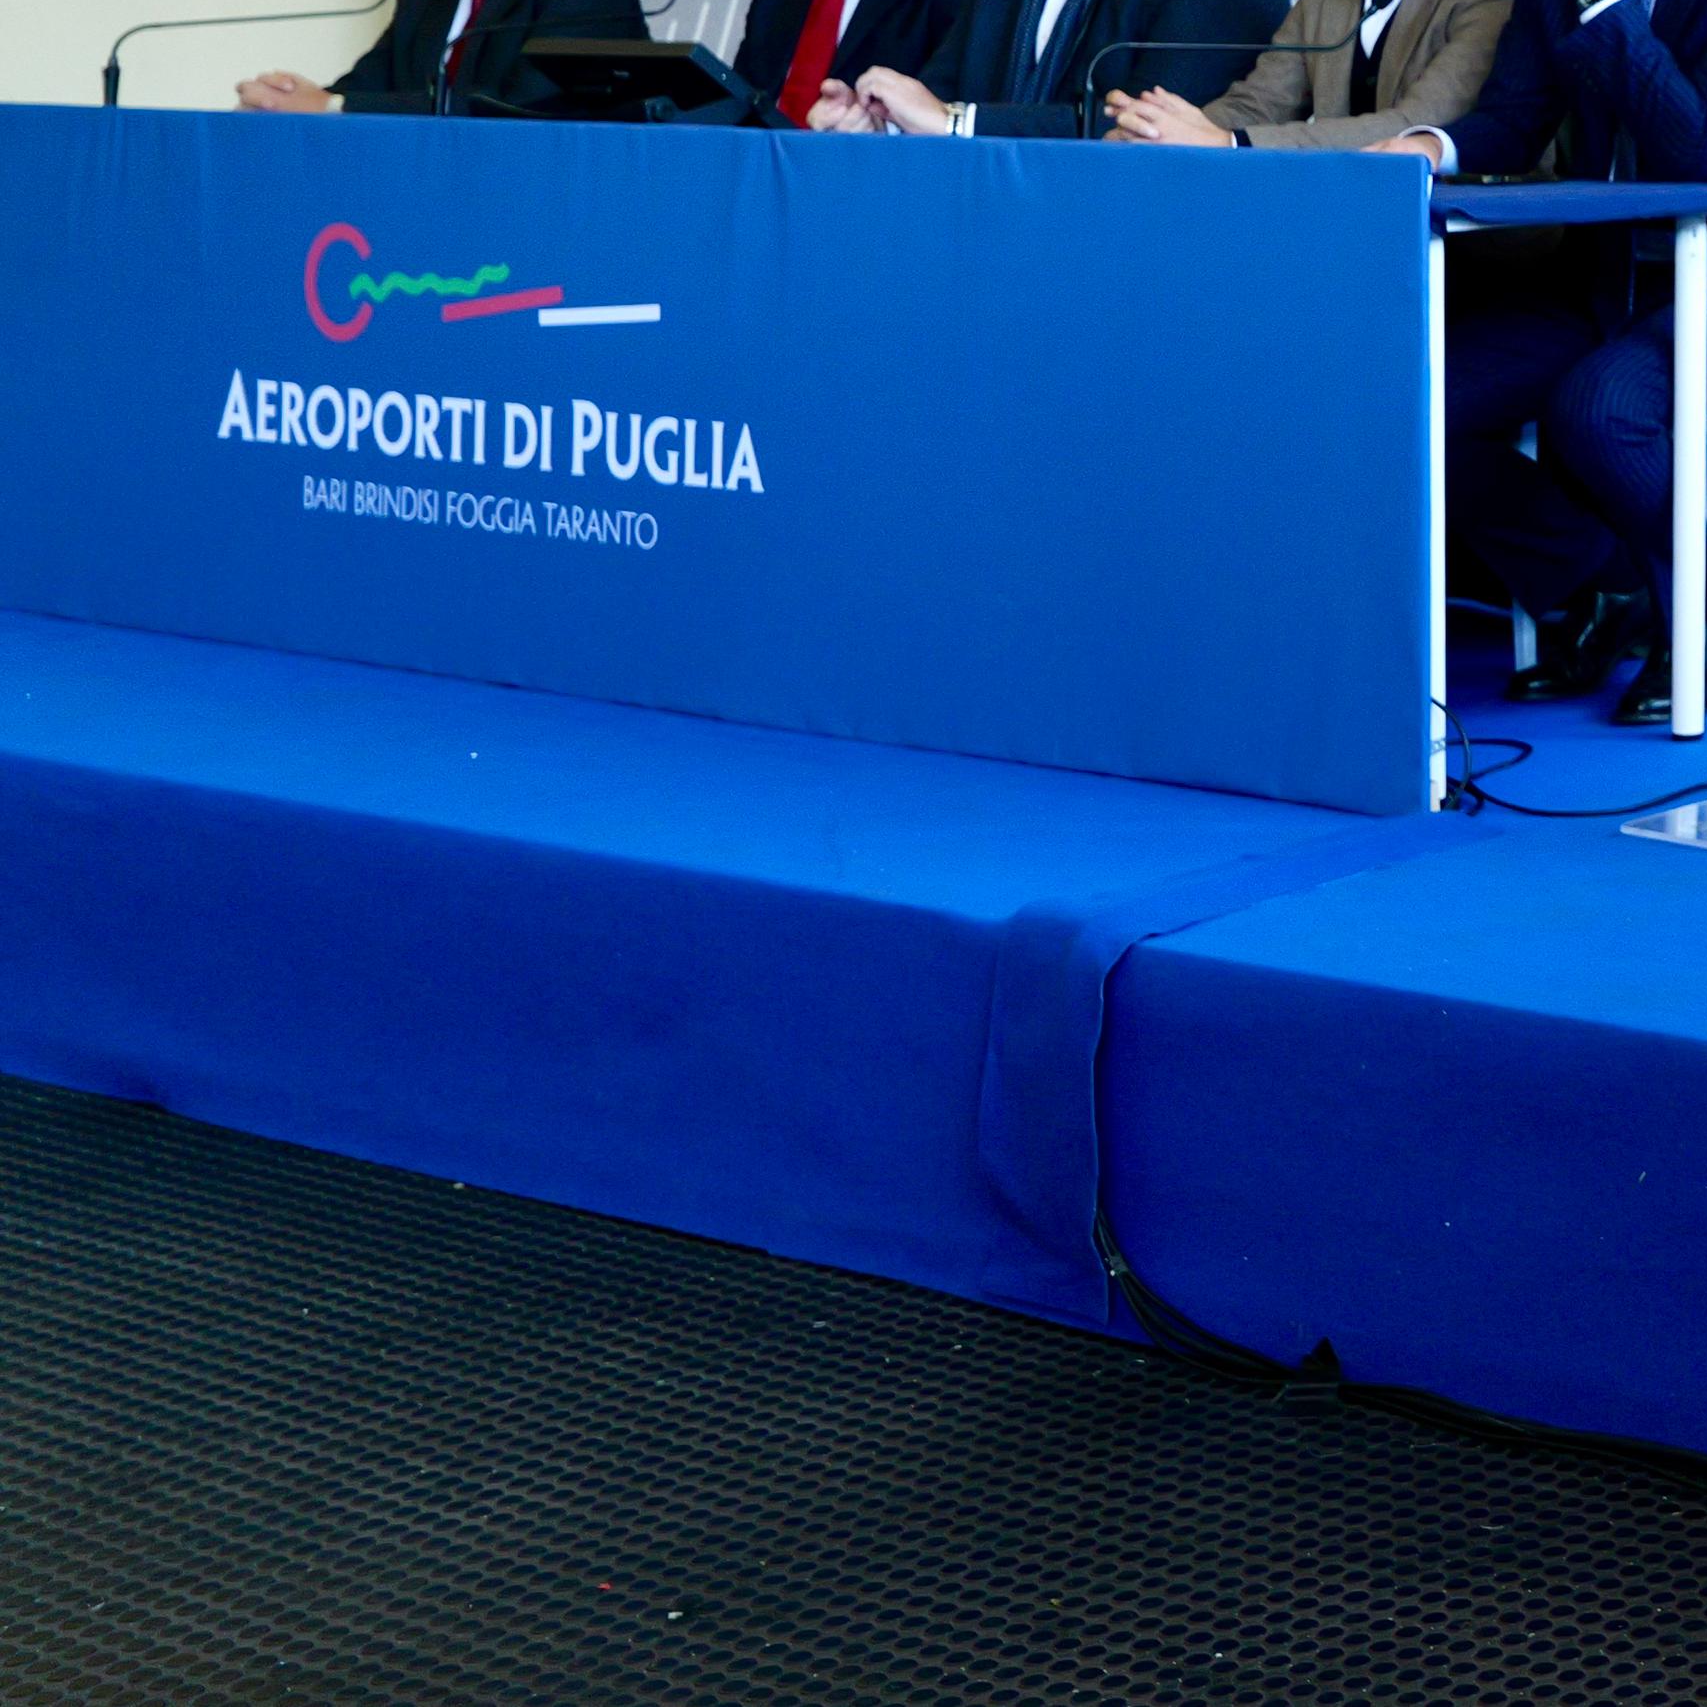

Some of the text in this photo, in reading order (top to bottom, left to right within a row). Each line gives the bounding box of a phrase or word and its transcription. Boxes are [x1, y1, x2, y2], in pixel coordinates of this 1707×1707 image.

[217, 368, 765, 494] AEROPORTI DI PUGLIA
[303, 474, 659, 550] BARI BRINDISI FOGGIA TARANTO
